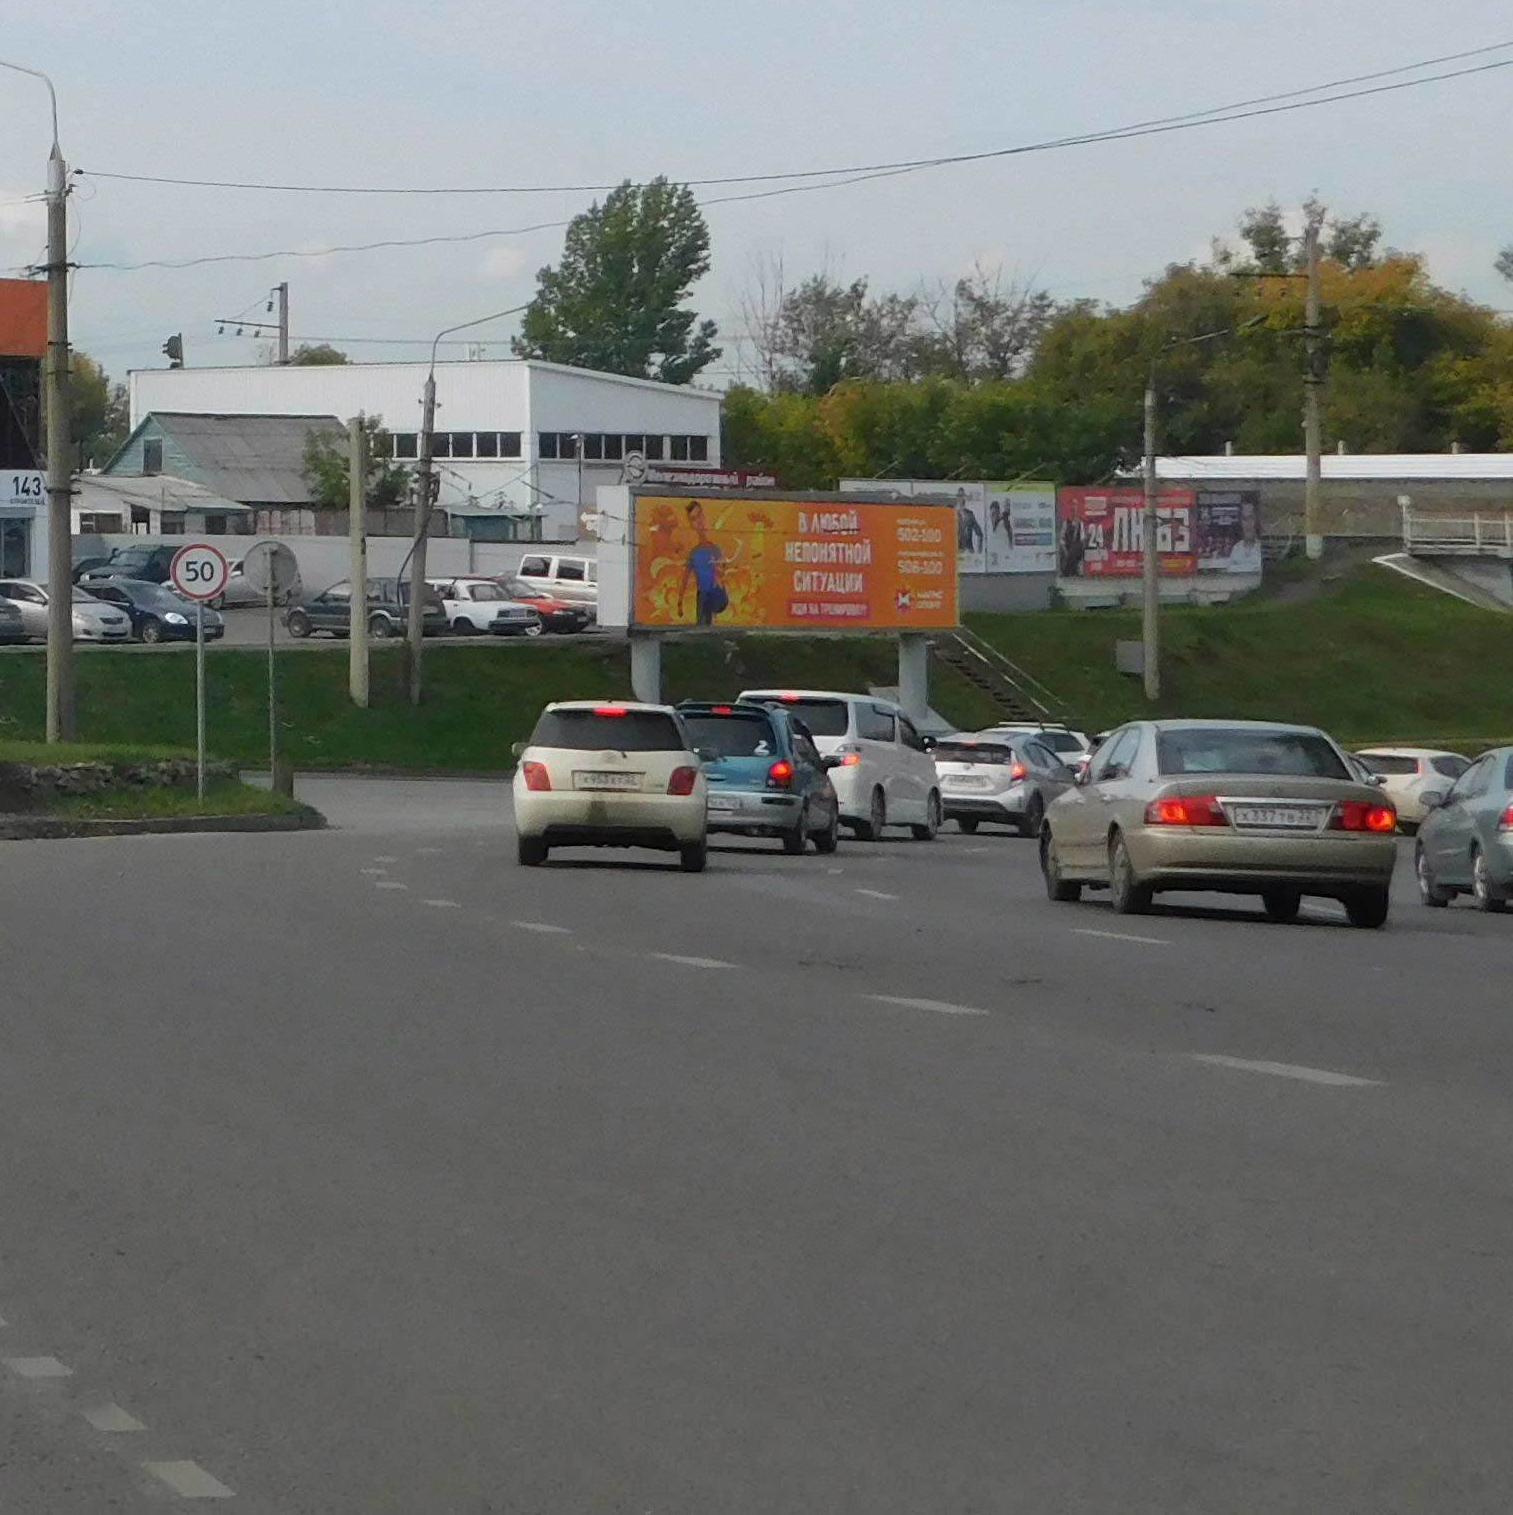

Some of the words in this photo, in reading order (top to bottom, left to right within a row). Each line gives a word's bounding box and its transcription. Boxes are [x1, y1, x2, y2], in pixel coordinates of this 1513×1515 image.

[12, 476, 41, 496] 143
[798, 512, 807, 533] В
[811, 509, 859, 534] ЛЮБОЙ
[785, 539, 872, 565] НЕПОНЯТНОЙ
[185, 560, 215, 582] 50
[793, 570, 864, 594] СИТУАЦИИ
